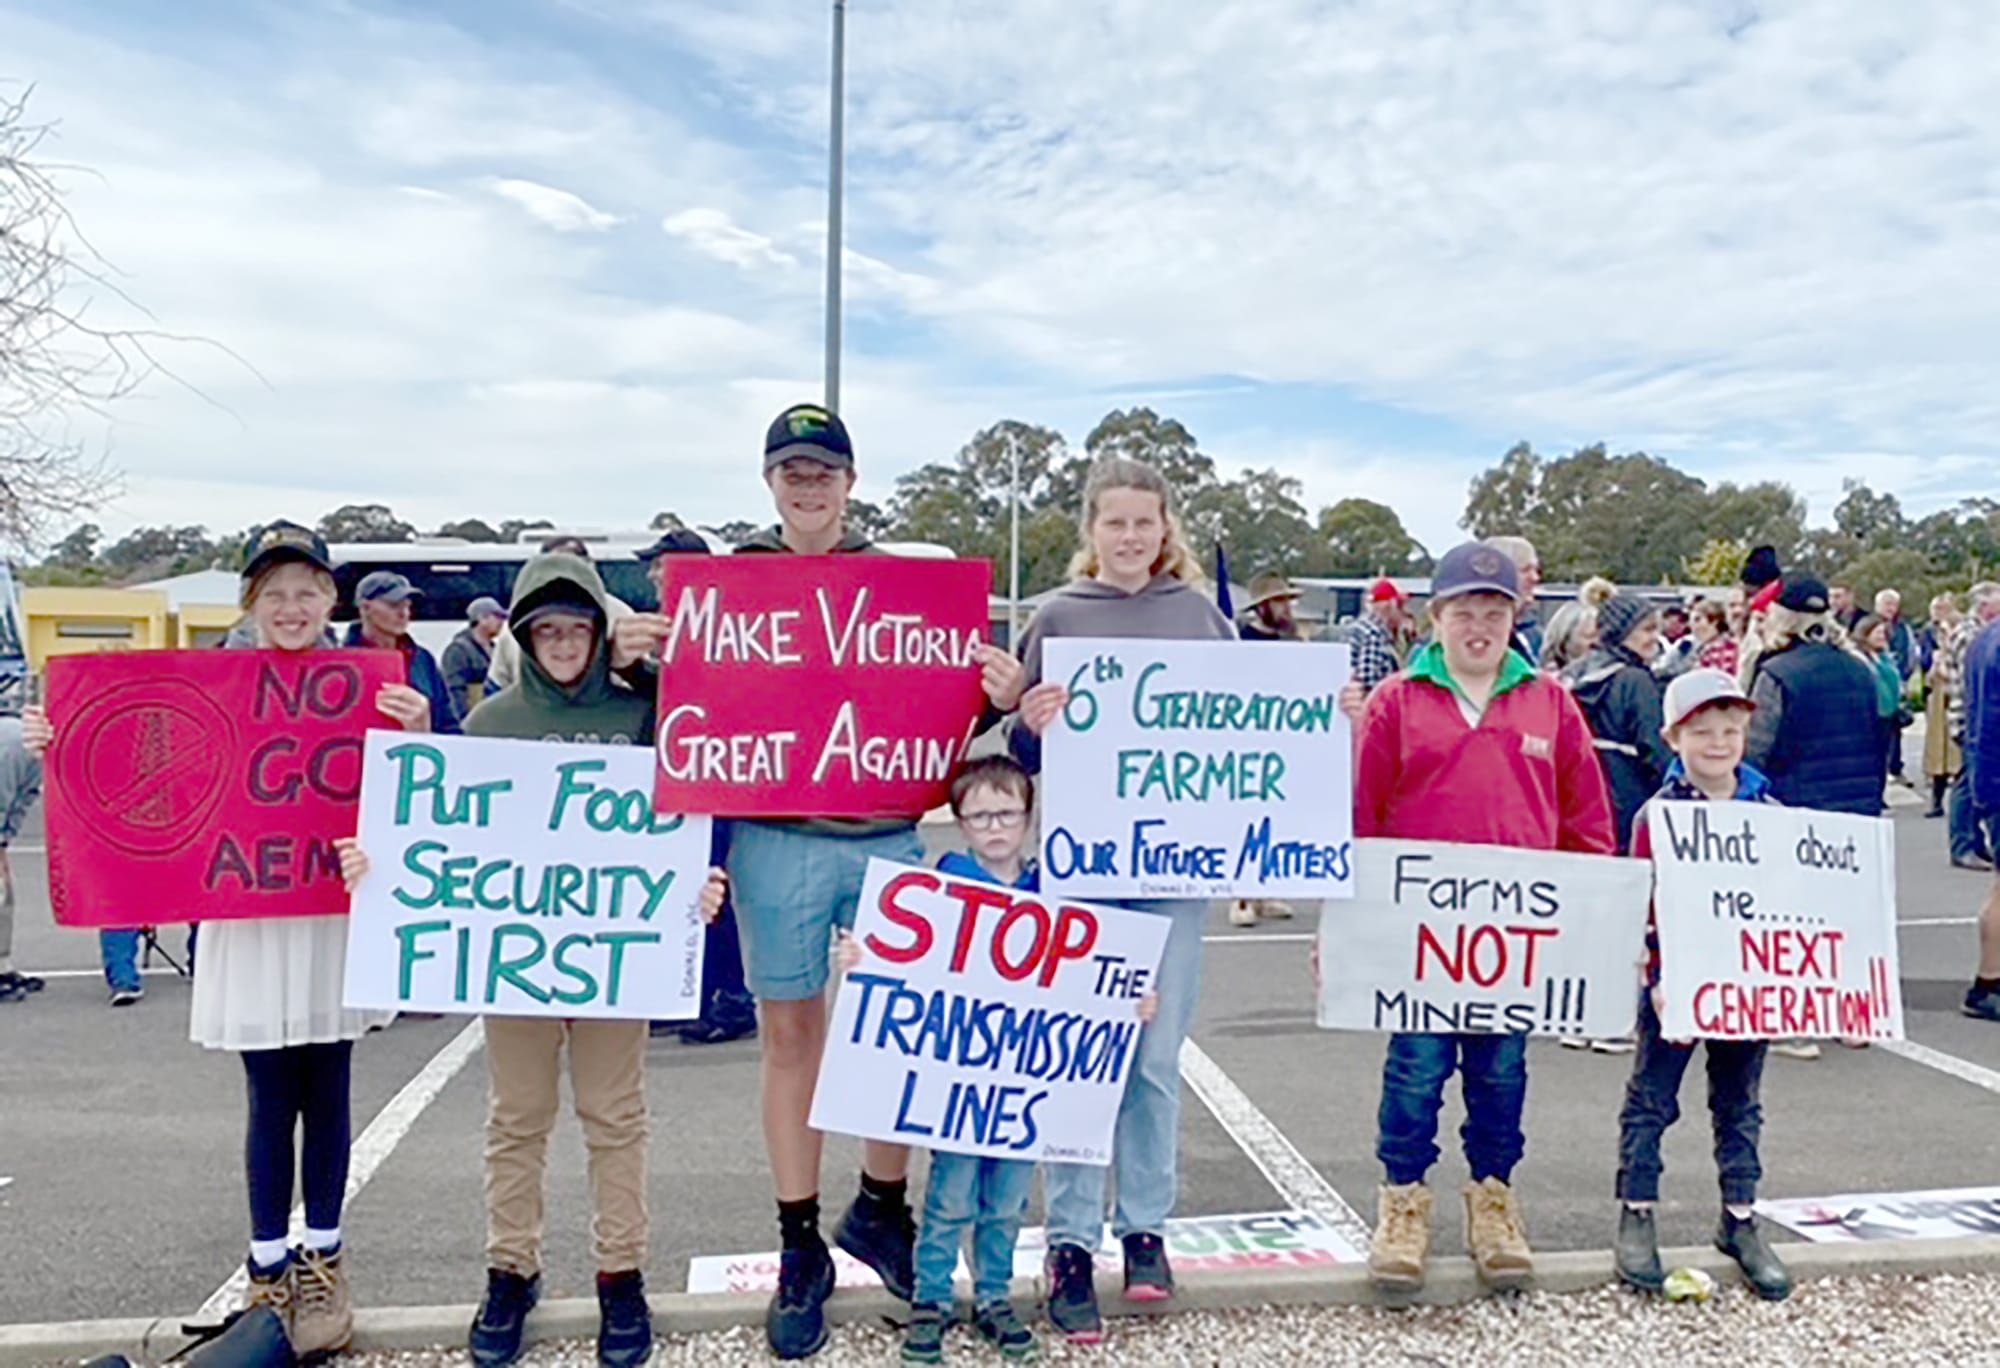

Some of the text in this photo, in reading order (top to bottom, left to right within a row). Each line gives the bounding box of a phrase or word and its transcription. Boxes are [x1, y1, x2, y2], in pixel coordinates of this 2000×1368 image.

[663, 586, 981, 667] MAKE VICTORIA
[253, 661, 361, 719] NO
[1064, 655, 1334, 733] 6th GENERATION
[248, 736, 365, 804] GO
[659, 704, 796, 782] GREAT
[1117, 749, 1286, 802] FARMER
[385, 742, 513, 827] PUT
[1045, 815, 1350, 884] OUR FUTURE MATTERS
[1663, 806, 1860, 873] What about
[391, 840, 676, 921] SECURITY
[394, 920, 662, 1006] FIRST
[864, 872, 1150, 998] STOP THE
[1415, 923, 1560, 988] NOT
[1740, 928, 1844, 980] NEXT
[846, 972, 1137, 1085] TRANSMISSION
[1374, 976, 1586, 1036] MINES!!!
[1692, 956, 1894, 1039] GENERATION!!
[894, 1069, 1049, 1151] LINES
